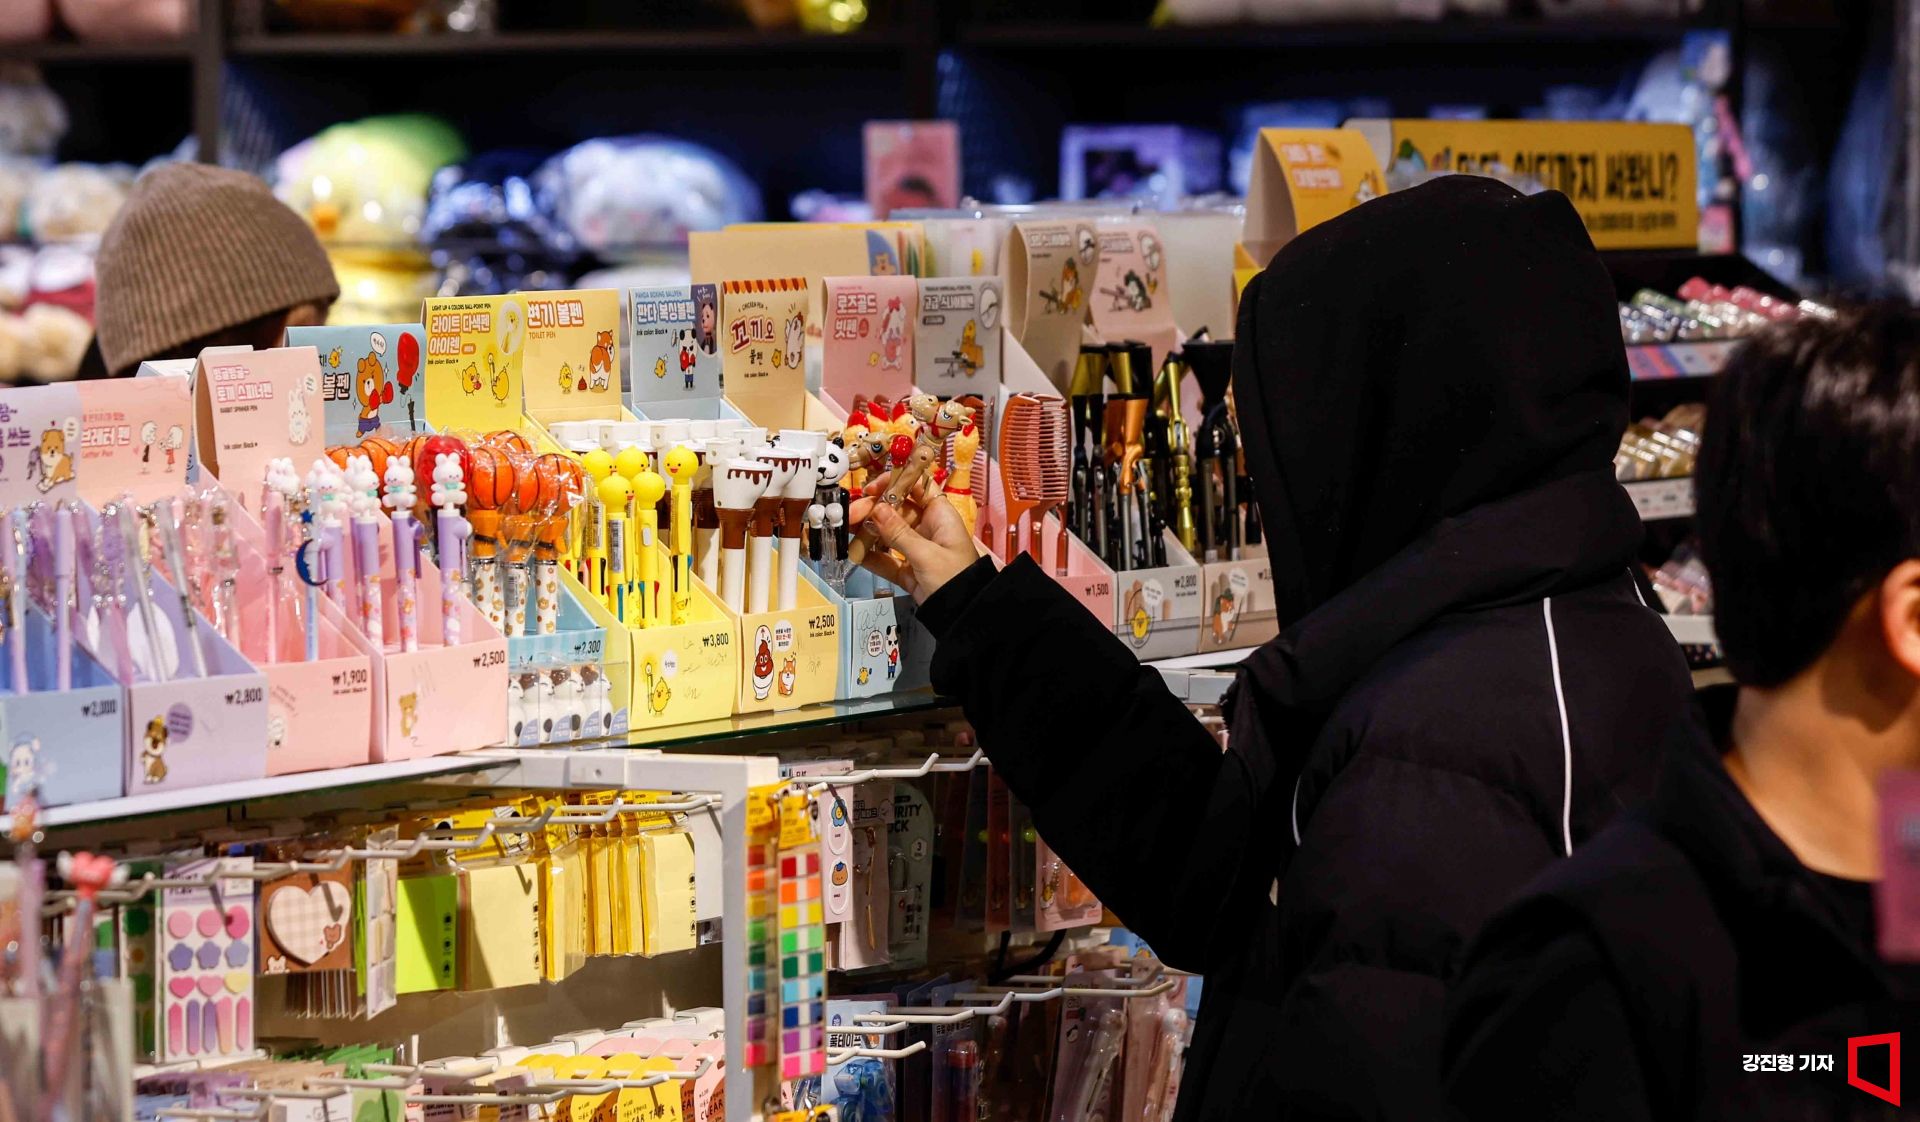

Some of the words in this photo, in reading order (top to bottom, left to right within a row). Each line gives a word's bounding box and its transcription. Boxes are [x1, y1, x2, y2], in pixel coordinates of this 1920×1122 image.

[637, 302, 658, 324] 판다
[659, 300, 696, 322] 복싱볼펜
[837, 293, 878, 314] 로즈골드
[431, 313, 461, 334] 라이트
[462, 312, 491, 333] 다색펜
[528, 301, 555, 328] 변기
[556, 300, 584, 327] 볼펜
[529, 332, 545, 340] TOILET
[546, 331, 556, 339] PEN
[731, 316, 774, 353] 꼬끼오
[834, 318, 859, 339] 빗펜
[238, 382, 274, 402] 스피너펜
[323, 372, 351, 401] 볼펜
[1085, 584, 1109, 596] ₩1,500
[809, 614, 835, 630] ₩2,500
[702, 632, 729, 648] ₩3,800
[473, 650, 505, 668] ₩2,500
[332, 669, 367, 686] ₩1,900
